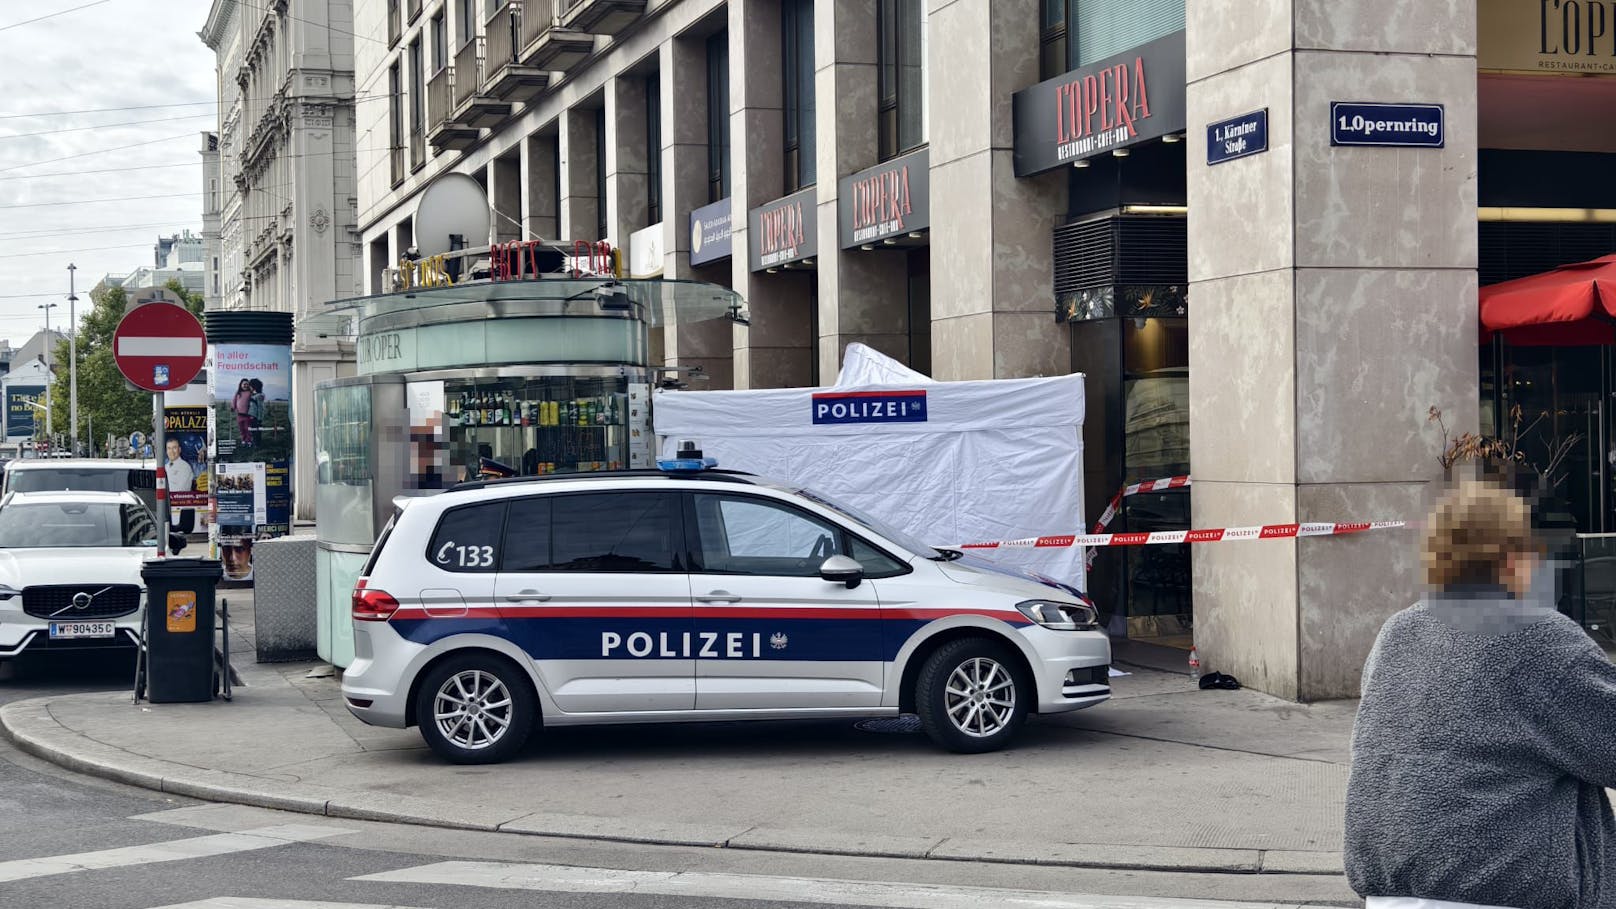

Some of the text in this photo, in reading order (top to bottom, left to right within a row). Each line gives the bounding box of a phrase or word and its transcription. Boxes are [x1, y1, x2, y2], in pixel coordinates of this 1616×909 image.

[1056, 56, 1152, 145] L'OPERA
[1224, 122, 1257, 139] Kärntner
[1225, 137, 1247, 154] Straße
[853, 165, 912, 231] L'OPERA
[760, 200, 805, 257] L'OPERA
[217, 351, 249, 360] In aller
[373, 333, 402, 361] OPER
[217, 361, 279, 371] Freundschaft
[817, 401, 907, 418] POLIZEI
[456, 545, 494, 567] 133
[58, 624, 112, 634] W 90435 C
[601, 631, 761, 658] POLIZEI
